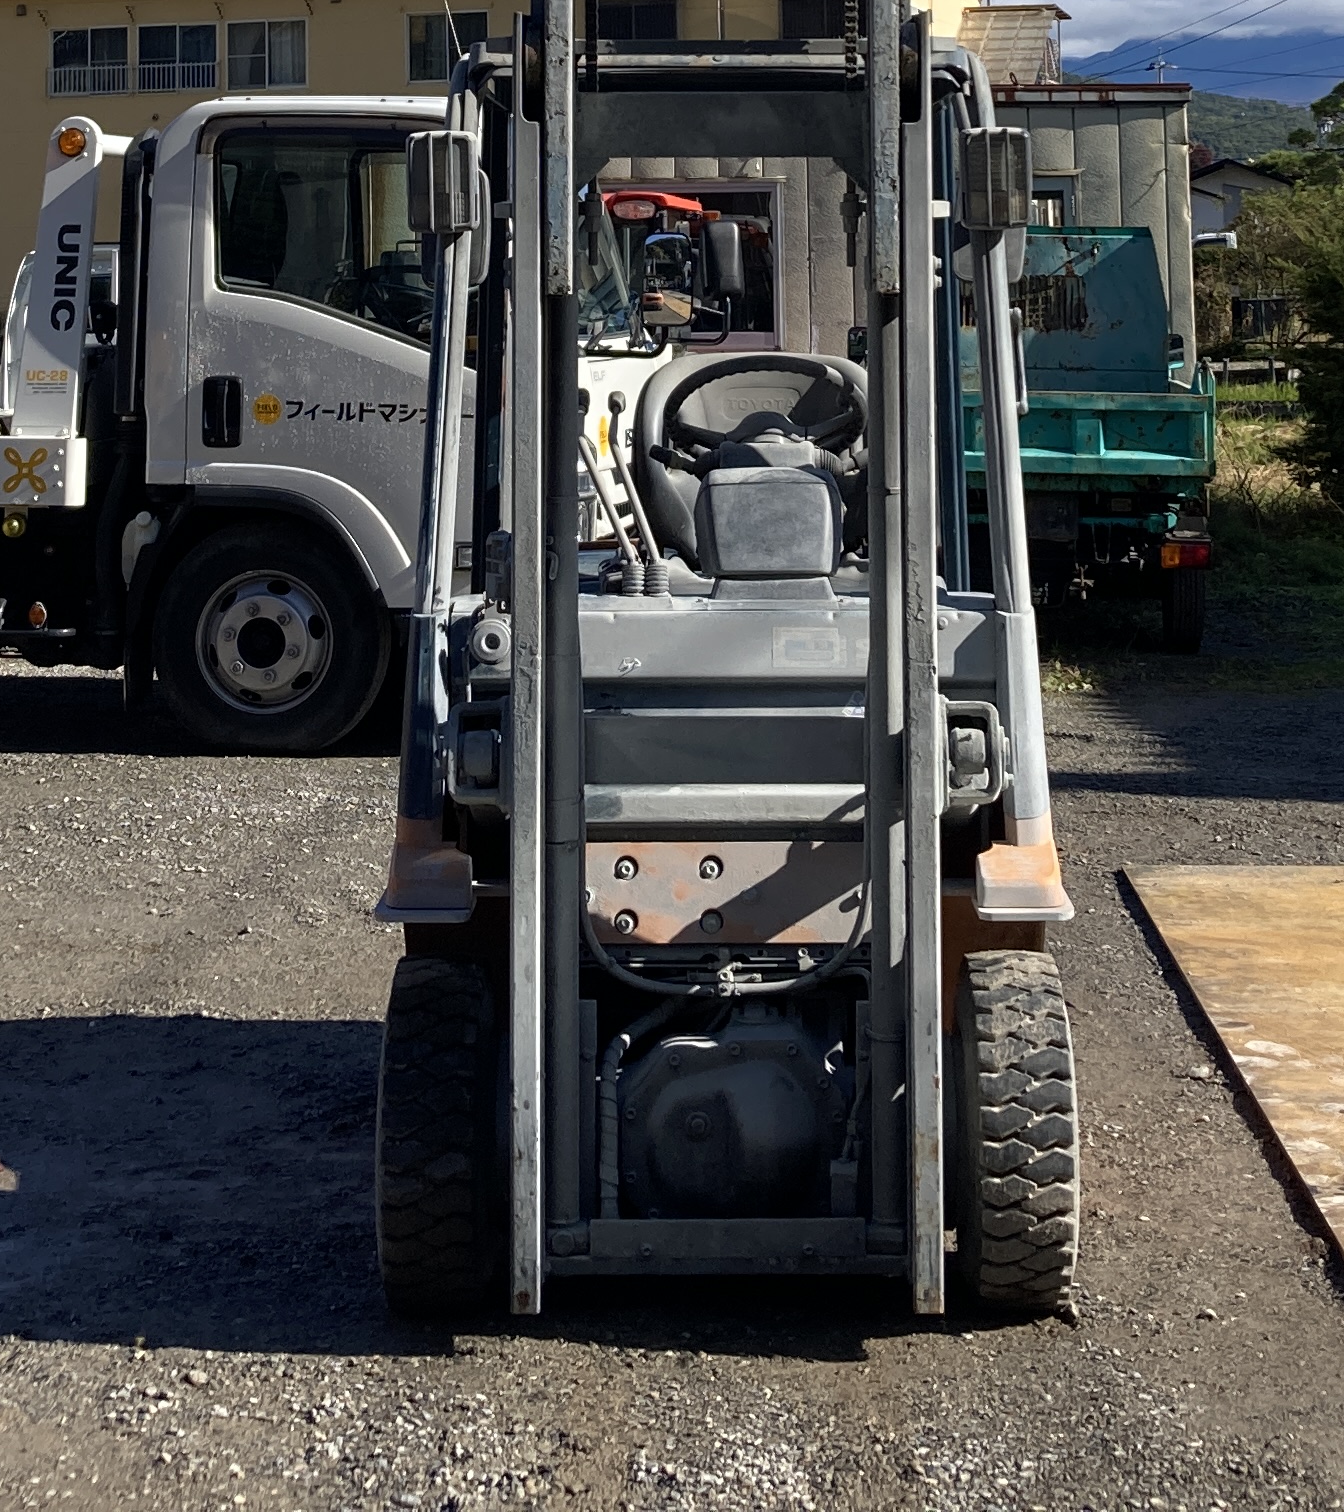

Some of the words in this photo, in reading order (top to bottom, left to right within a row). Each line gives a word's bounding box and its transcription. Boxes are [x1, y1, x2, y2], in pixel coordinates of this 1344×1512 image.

[50, 224, 81, 331] UNIC
[26, 370, 68, 382] UC-28
[727, 399, 795, 411] TOYOTA
